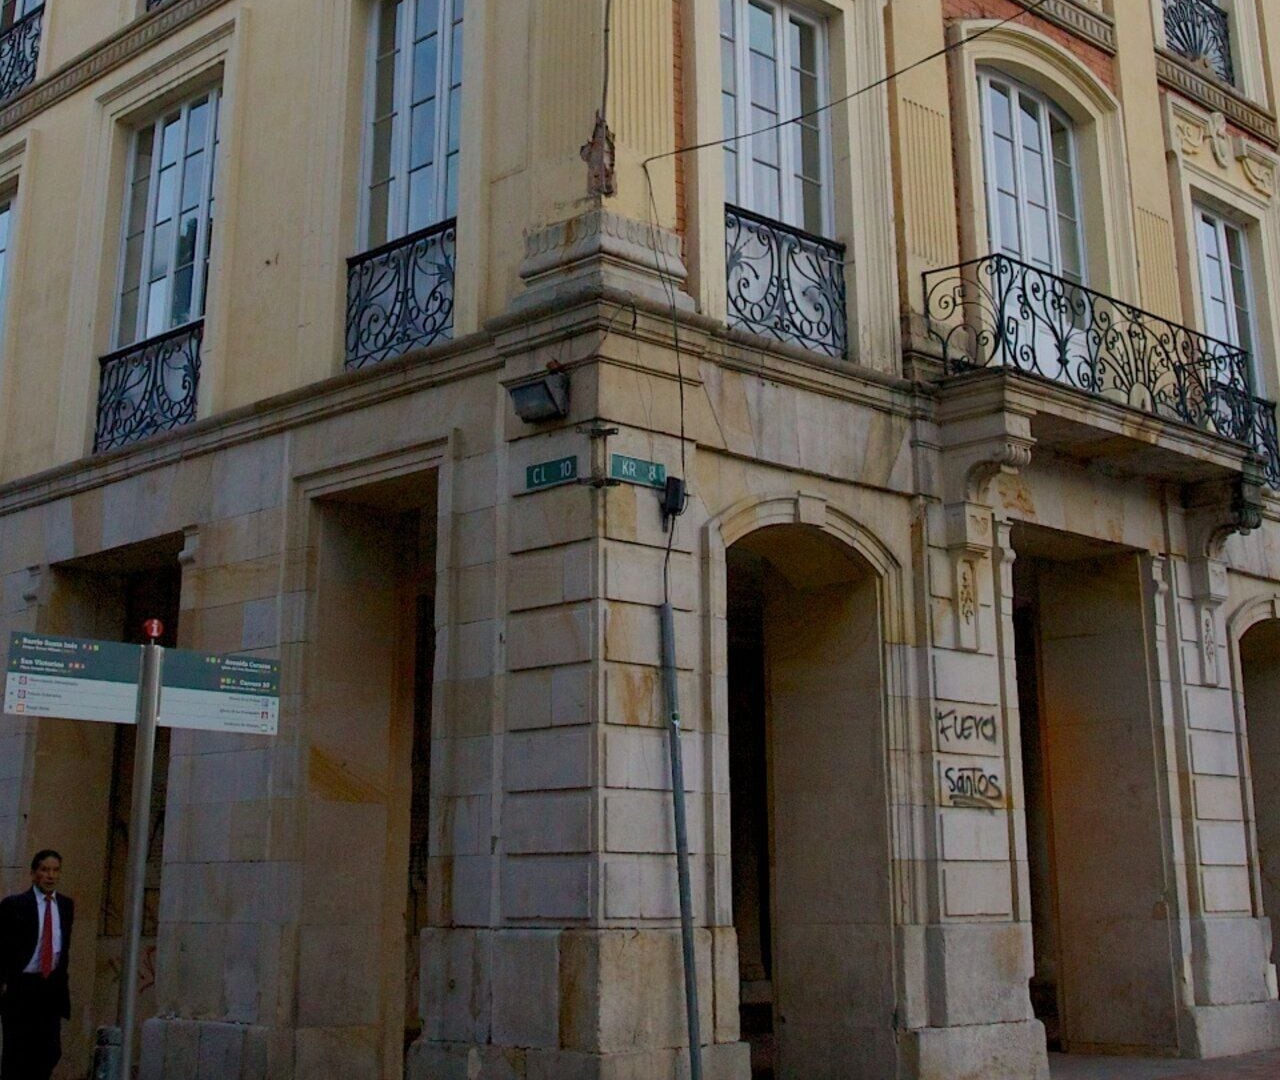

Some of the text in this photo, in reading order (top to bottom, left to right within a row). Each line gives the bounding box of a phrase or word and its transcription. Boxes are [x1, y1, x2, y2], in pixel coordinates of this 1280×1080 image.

[532, 460, 572, 484] CL 10
[622, 460, 657, 481] KR 8
